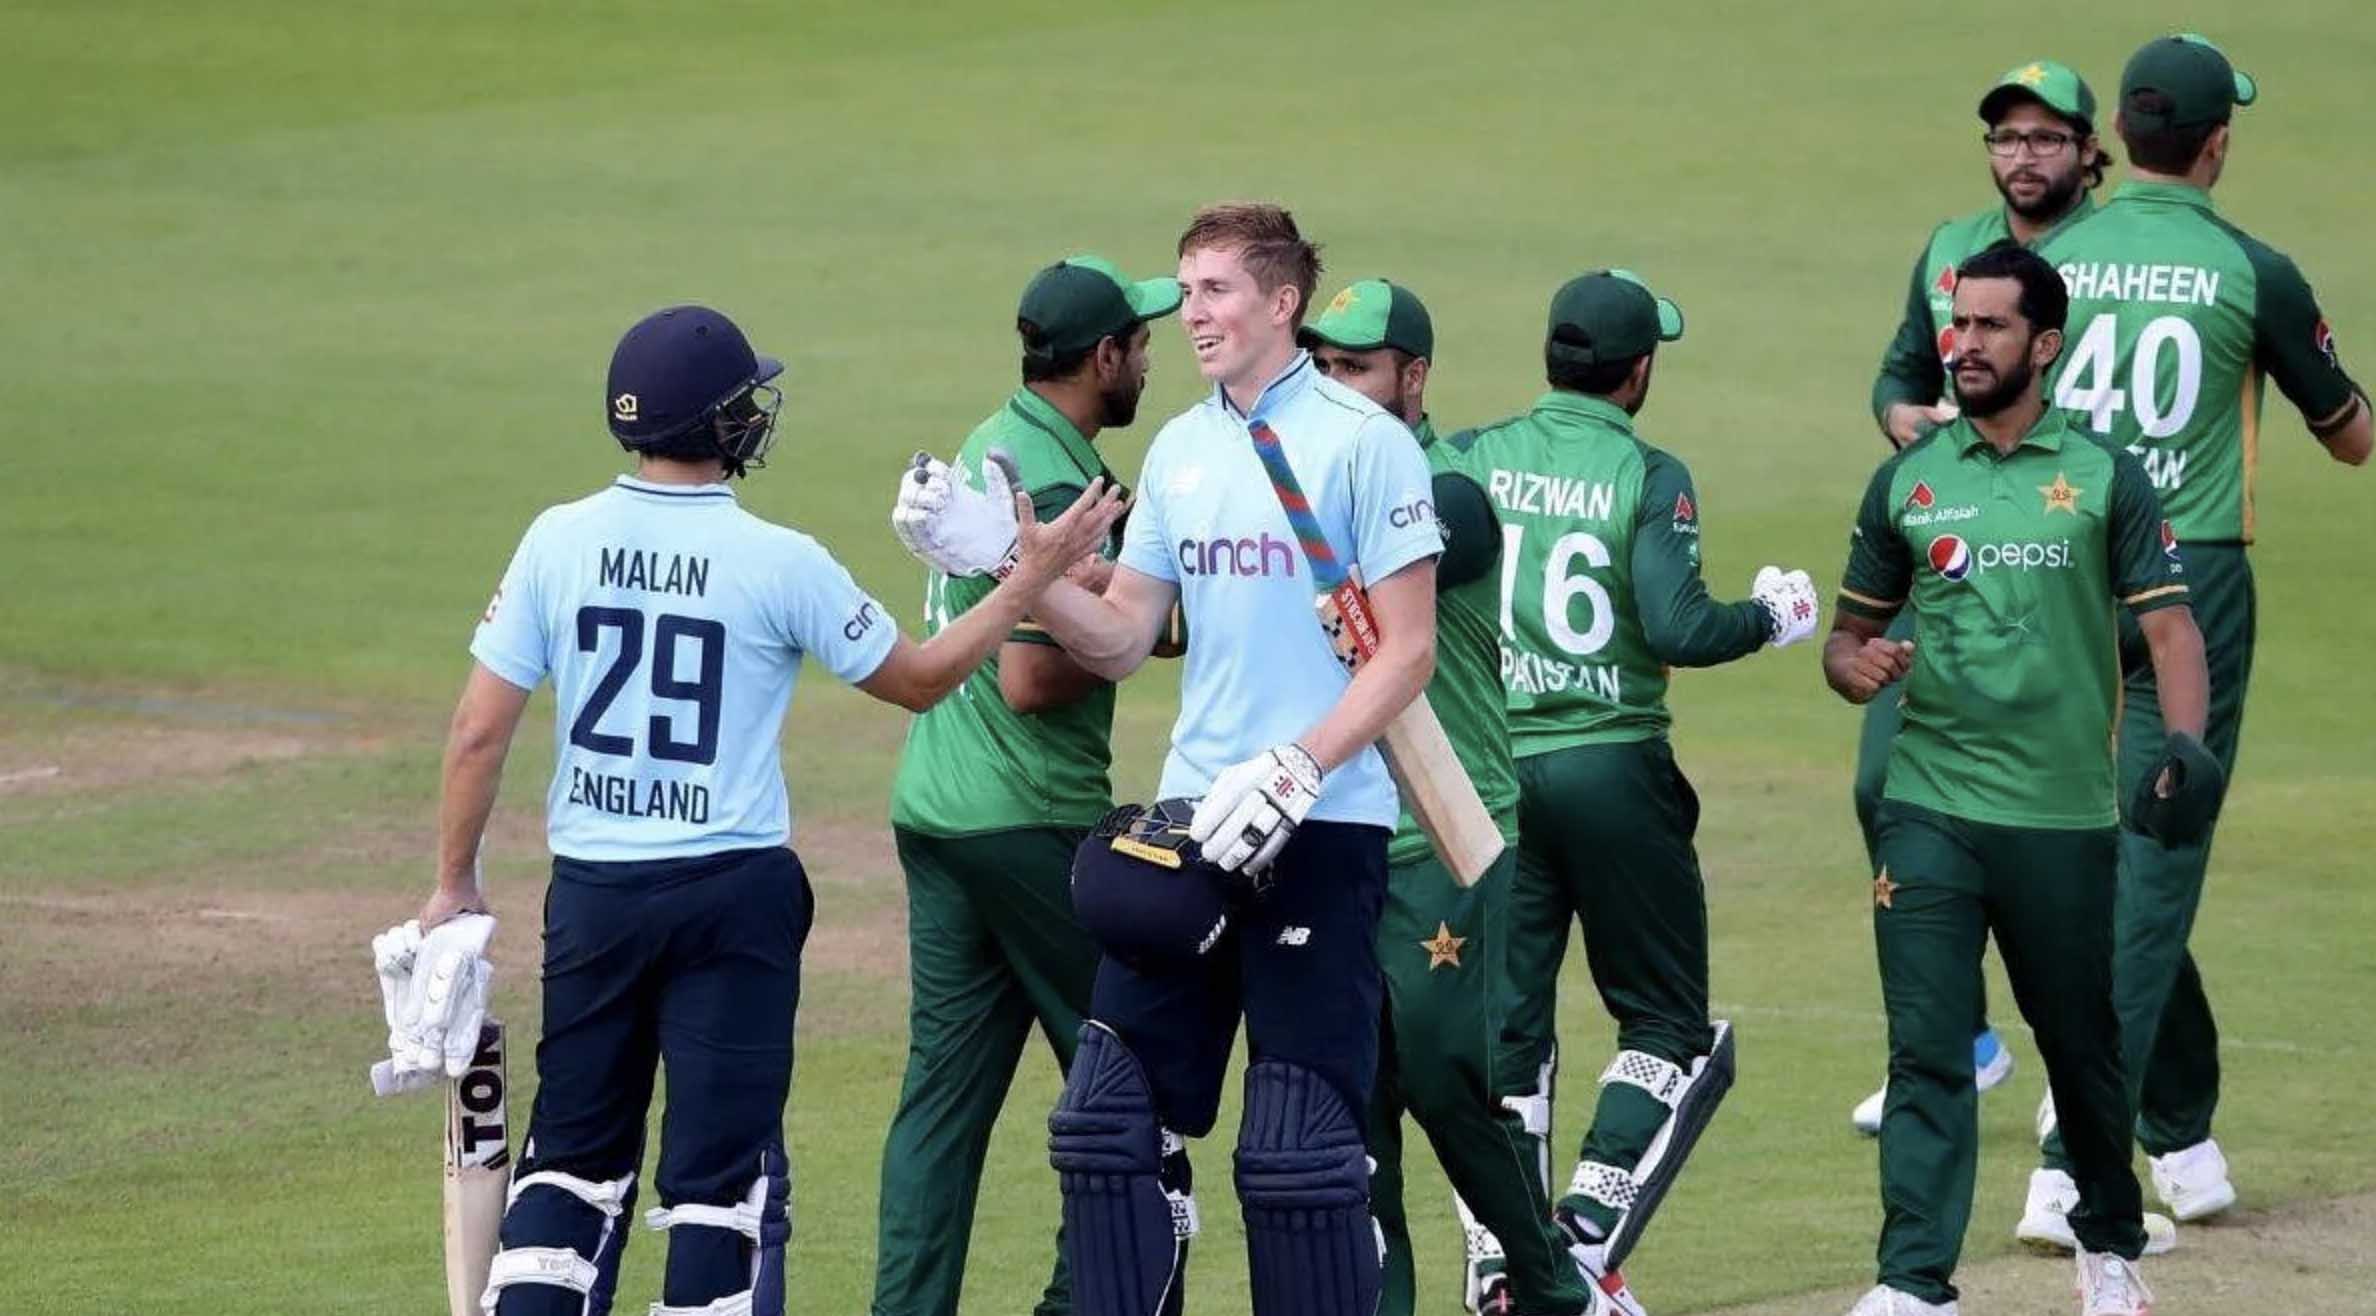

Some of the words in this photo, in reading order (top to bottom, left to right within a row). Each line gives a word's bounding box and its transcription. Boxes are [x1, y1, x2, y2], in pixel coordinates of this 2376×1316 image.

[2057, 262, 2219, 306] SHAHEEN
[2054, 313, 2203, 438] 40
[1489, 468, 1614, 521] RIZWAN
[600, 547, 710, 597] MALAN
[1179, 532, 1294, 577] cinch
[1979, 539, 2069, 575] pepsi
[1500, 523, 1615, 656] 16
[570, 605, 727, 766] 29
[568, 765, 709, 825] ENGLAND
